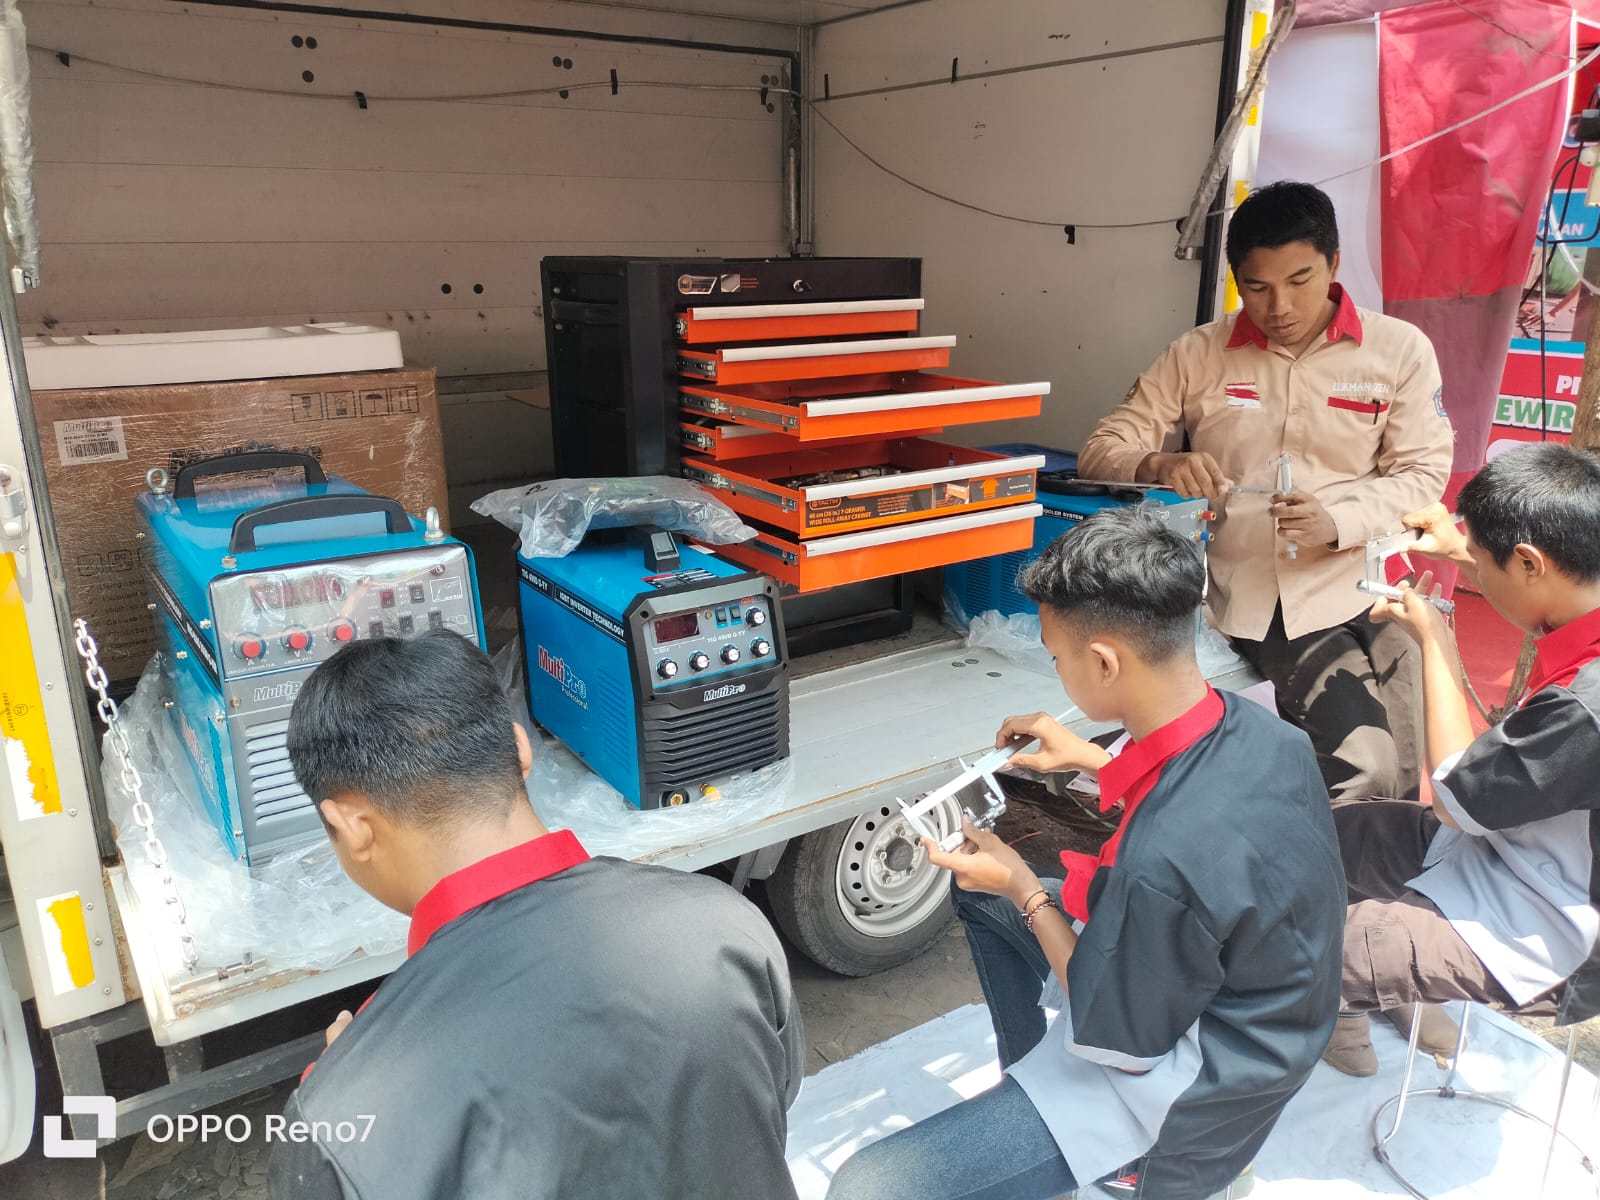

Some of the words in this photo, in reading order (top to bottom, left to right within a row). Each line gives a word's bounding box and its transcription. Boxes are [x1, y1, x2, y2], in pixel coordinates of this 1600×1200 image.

[1332, 383, 1370, 392] LUKMAN
[1374, 383, 1390, 393] ZEN
[851, 512, 872, 520] CABINET
[1062, 512, 1084, 521] SYSTEM
[570, 598, 592, 618] INVERTER
[592, 611, 625, 638] TECHNOLOGY
[538, 644, 587, 699] MultiPro
[703, 683, 747, 702] MultiPro
